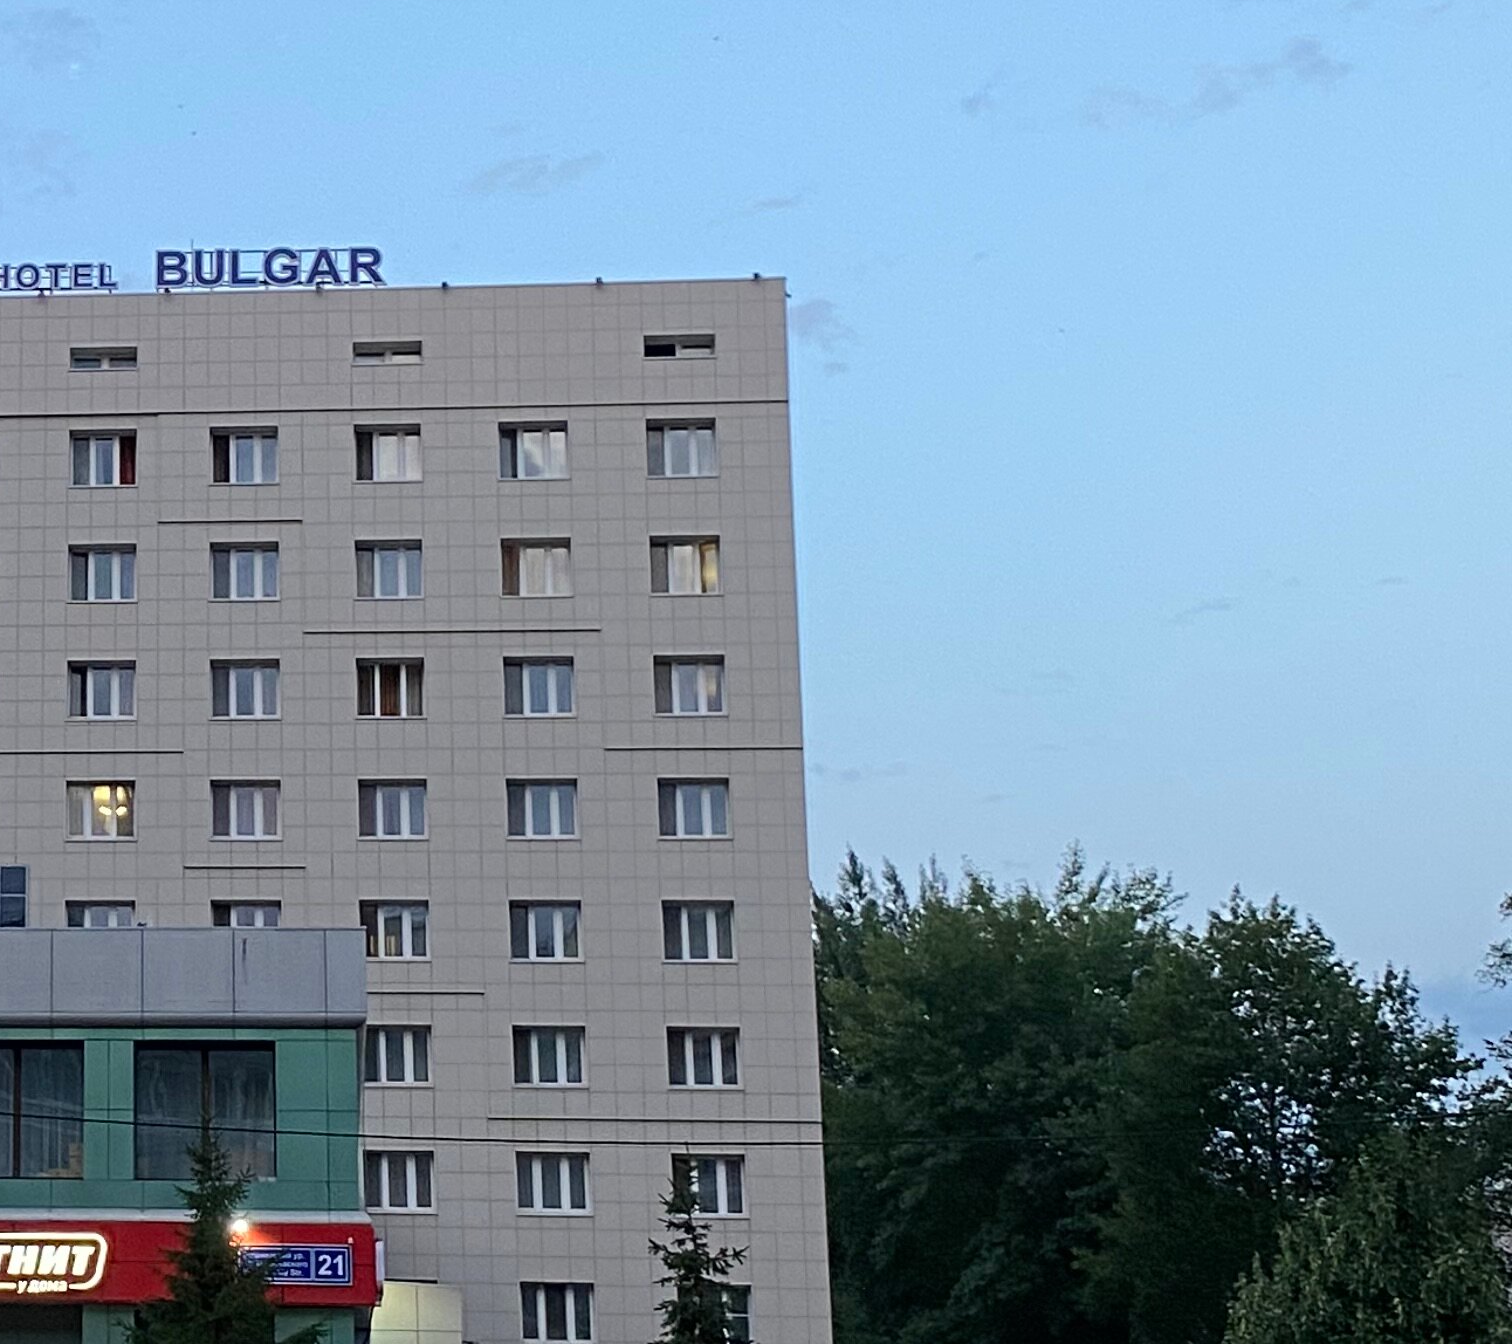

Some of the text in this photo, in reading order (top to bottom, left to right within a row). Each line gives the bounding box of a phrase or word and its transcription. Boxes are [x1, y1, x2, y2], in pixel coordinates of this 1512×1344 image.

[155, 247, 387, 289] BULGAR
[317, 1254, 344, 1276] 21
[17, 1279, 28, 1294] у
